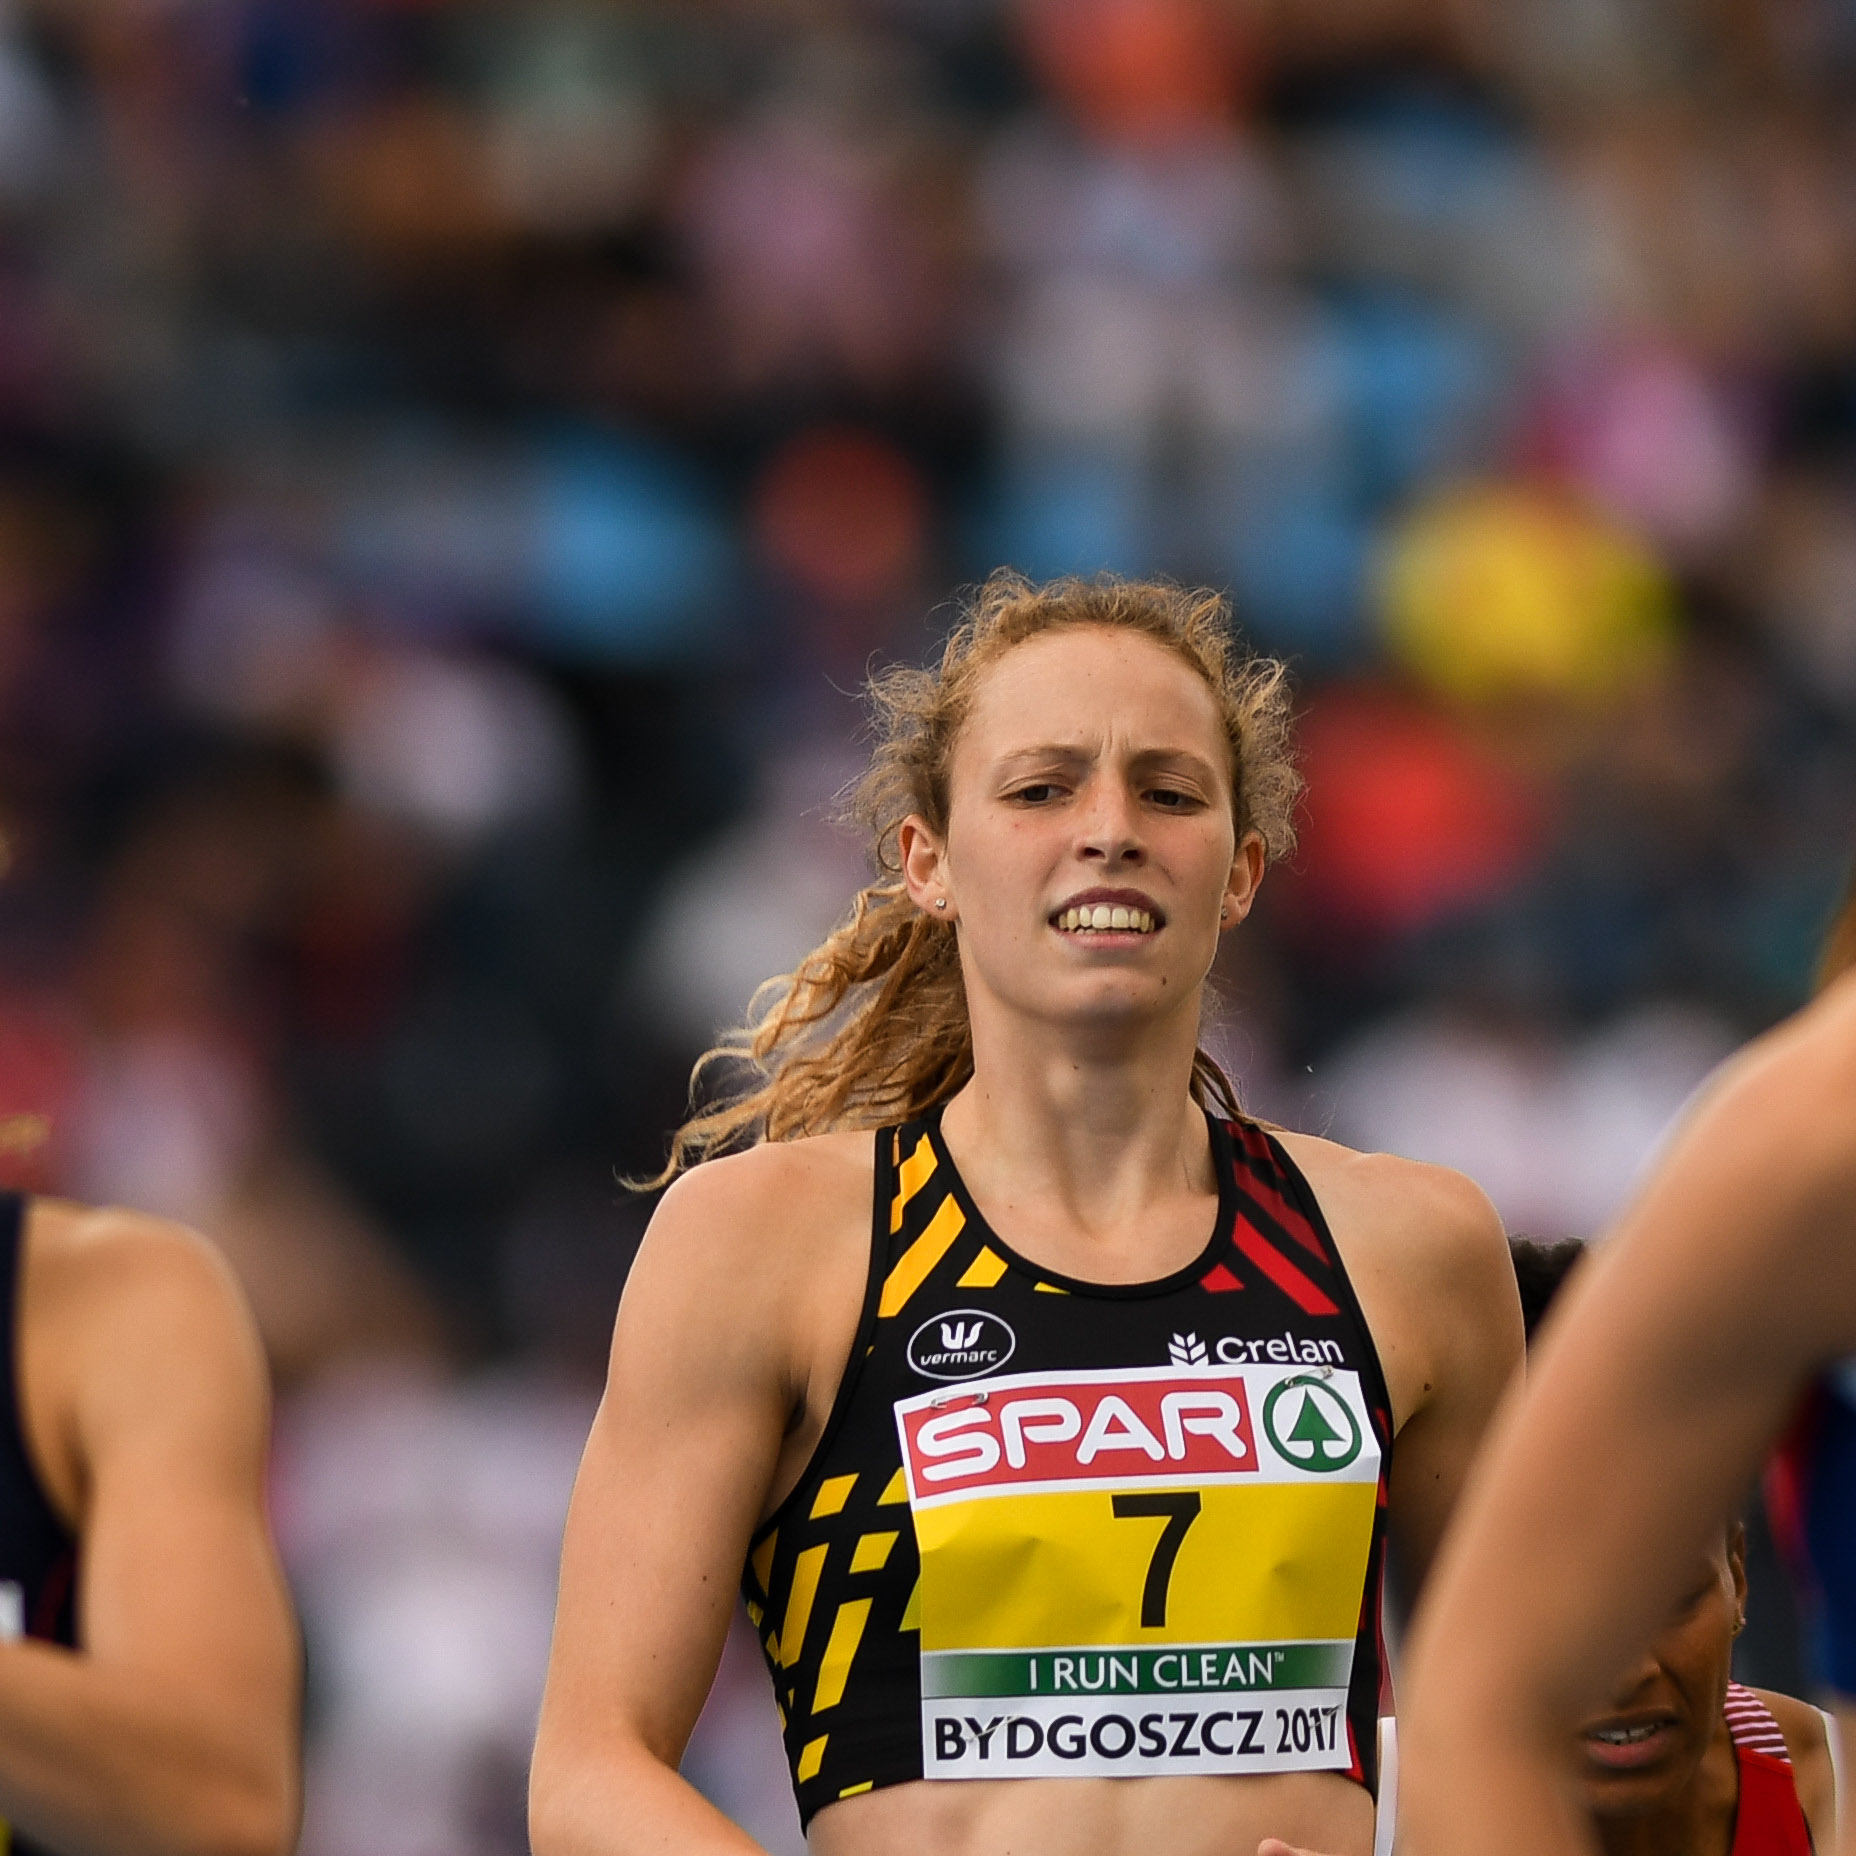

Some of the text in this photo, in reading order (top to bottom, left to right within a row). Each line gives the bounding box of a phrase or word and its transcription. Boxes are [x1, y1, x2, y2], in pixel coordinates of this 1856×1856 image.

[920, 1347, 999, 1366] vermarc
[1216, 1332, 1344, 1365] Crelan
[915, 1389, 1247, 1482] SPAR
[1110, 1491, 1202, 1629] 7
[1029, 1658, 1038, 1690] I
[1054, 1653, 1138, 1690] RUN
[934, 1706, 1340, 1762] BYDGOSZCZ 2017
